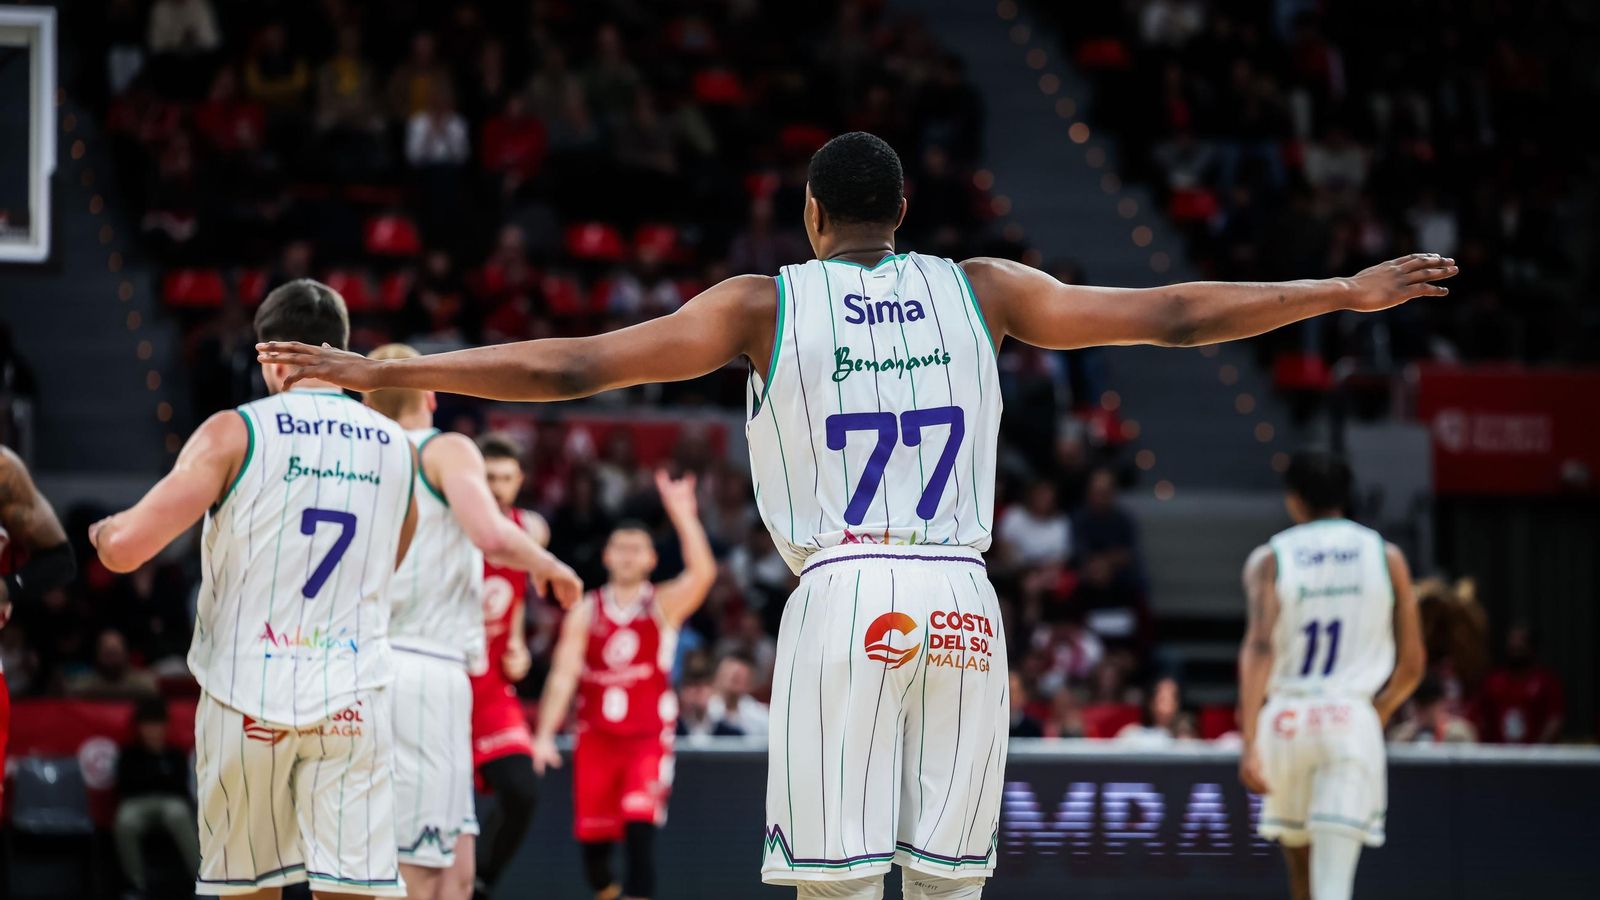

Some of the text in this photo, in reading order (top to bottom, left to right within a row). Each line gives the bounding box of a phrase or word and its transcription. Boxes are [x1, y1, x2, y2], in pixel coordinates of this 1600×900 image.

[843, 293, 926, 325] Sima
[275, 412, 391, 445] Barreiro
[825, 405, 965, 526] 77
[300, 508, 357, 599] 7
[929, 610, 993, 638] COSTA
[929, 634, 966, 651] DEL
[1299, 618, 1343, 678] 11
